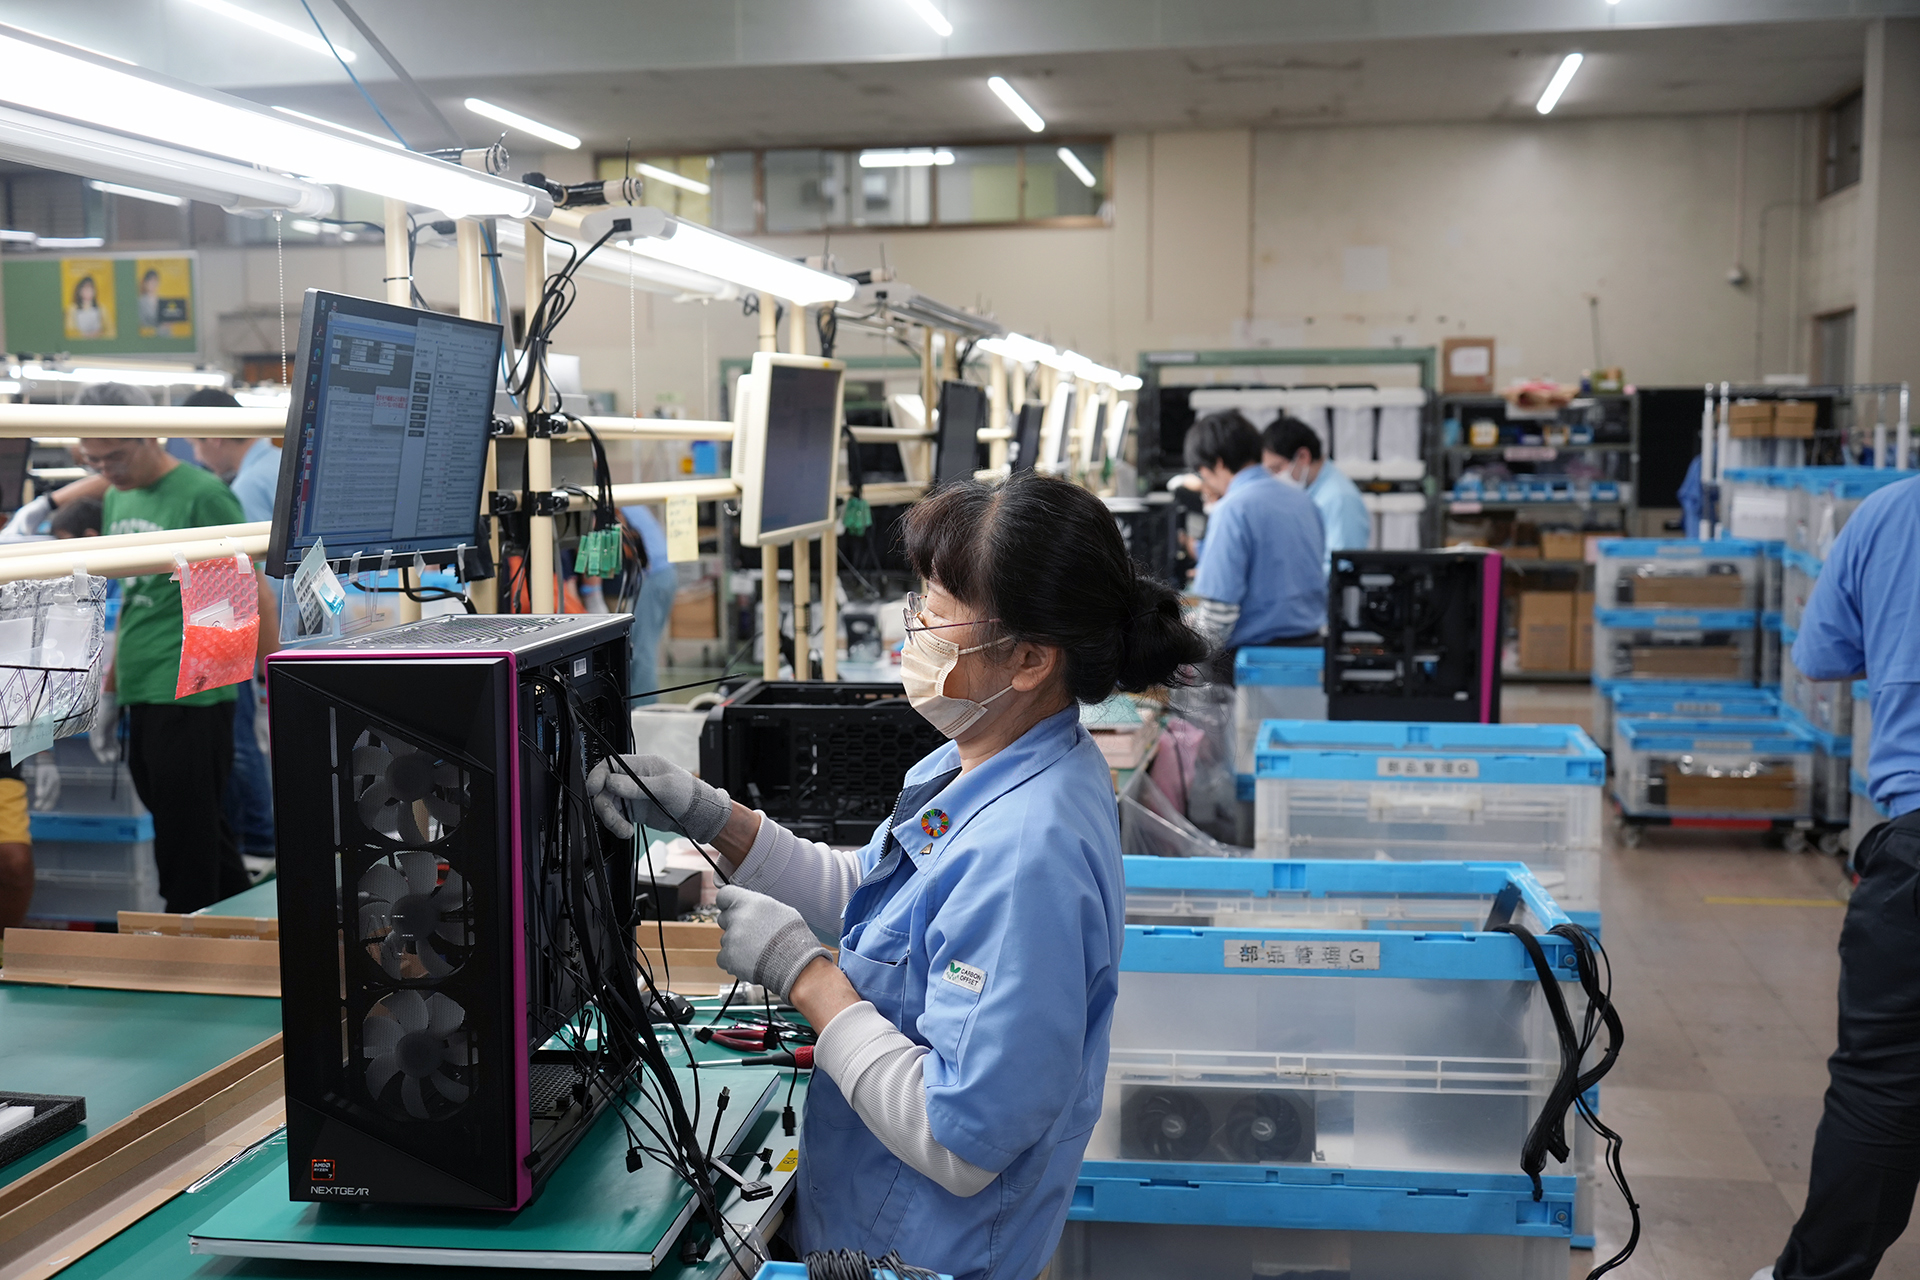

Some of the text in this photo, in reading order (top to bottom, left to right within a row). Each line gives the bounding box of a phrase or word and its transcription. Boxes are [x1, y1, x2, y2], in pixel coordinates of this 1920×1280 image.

[1240, 944, 1364, 964] 部品管理G
[961, 968, 982, 980] CARBON
[960, 975, 978, 986] OFFSET
[310, 1186, 370, 1196] NEXTGEAR
